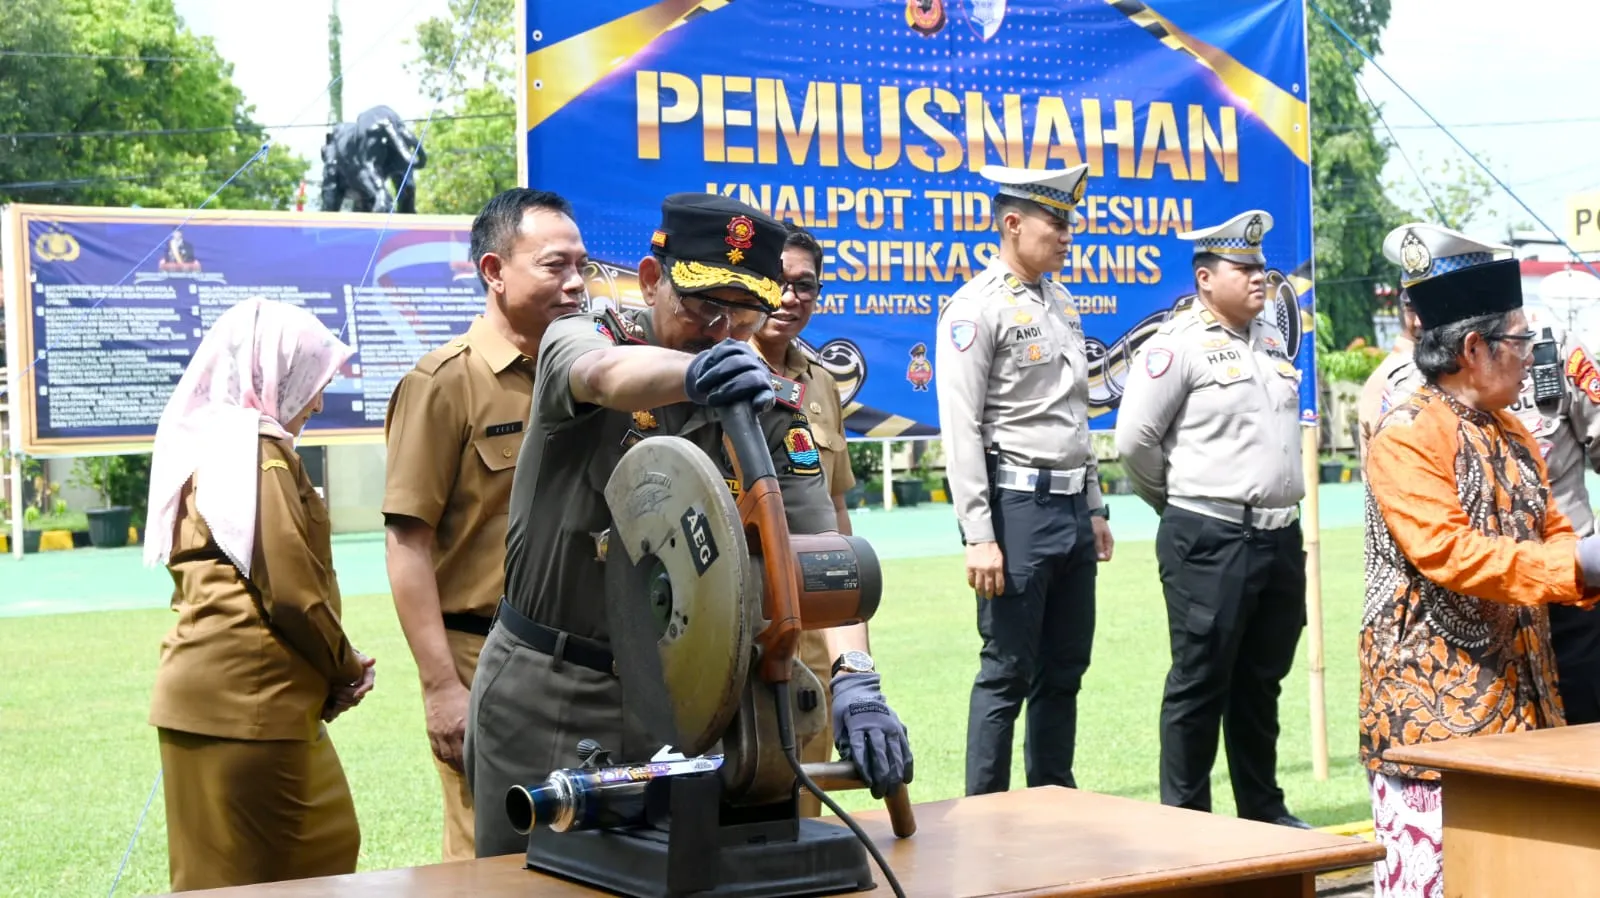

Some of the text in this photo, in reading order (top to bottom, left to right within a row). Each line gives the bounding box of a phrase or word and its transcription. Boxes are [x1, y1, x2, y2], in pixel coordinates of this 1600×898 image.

[636, 70, 1239, 182] PEMUSNAHAN
[924, 189, 1001, 232] TID
[1576, 208, 1600, 236] P
[820, 240, 1162, 285] ESIFIKAS EKNIS
[855, 294, 933, 315] LANTAS
[1073, 295, 1117, 315] EBON
[1016, 326, 1042, 341] ANDI
[1207, 350, 1242, 365] HADI
[686, 511, 711, 567] AEG
